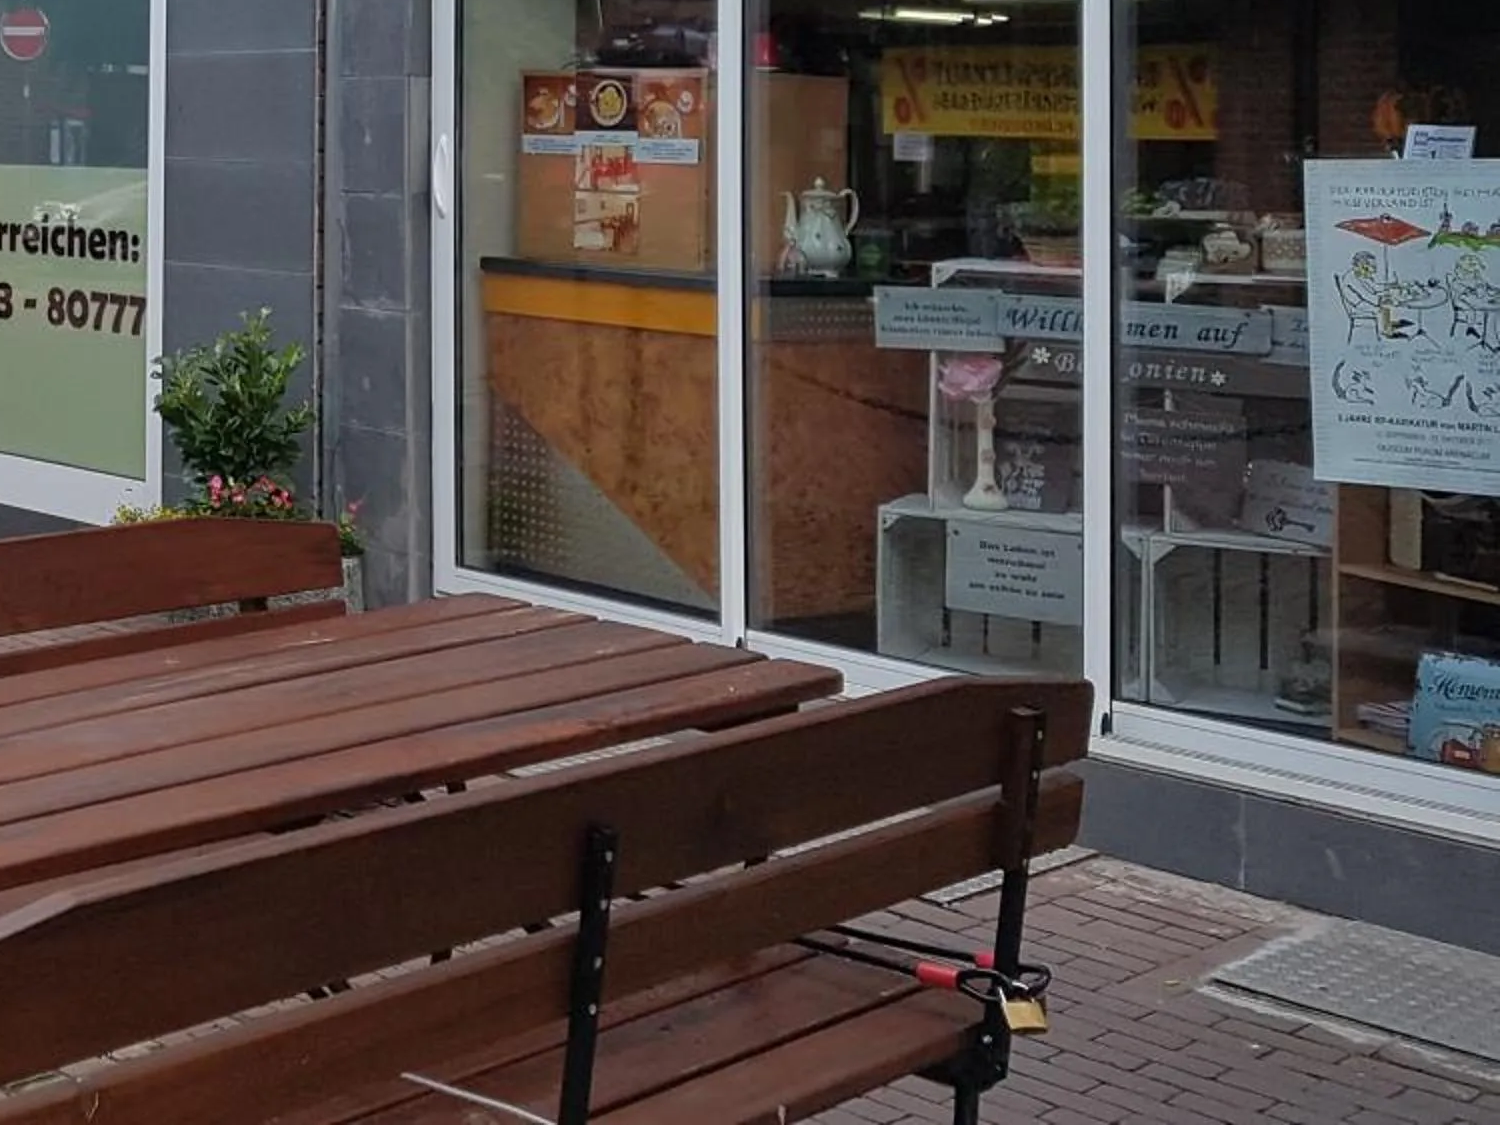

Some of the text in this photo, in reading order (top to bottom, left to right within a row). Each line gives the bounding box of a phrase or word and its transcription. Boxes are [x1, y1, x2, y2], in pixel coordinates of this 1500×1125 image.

[23, 297, 37, 310] -
[46, 286, 147, 337] 80777
[1196, 321, 1249, 349] auf
